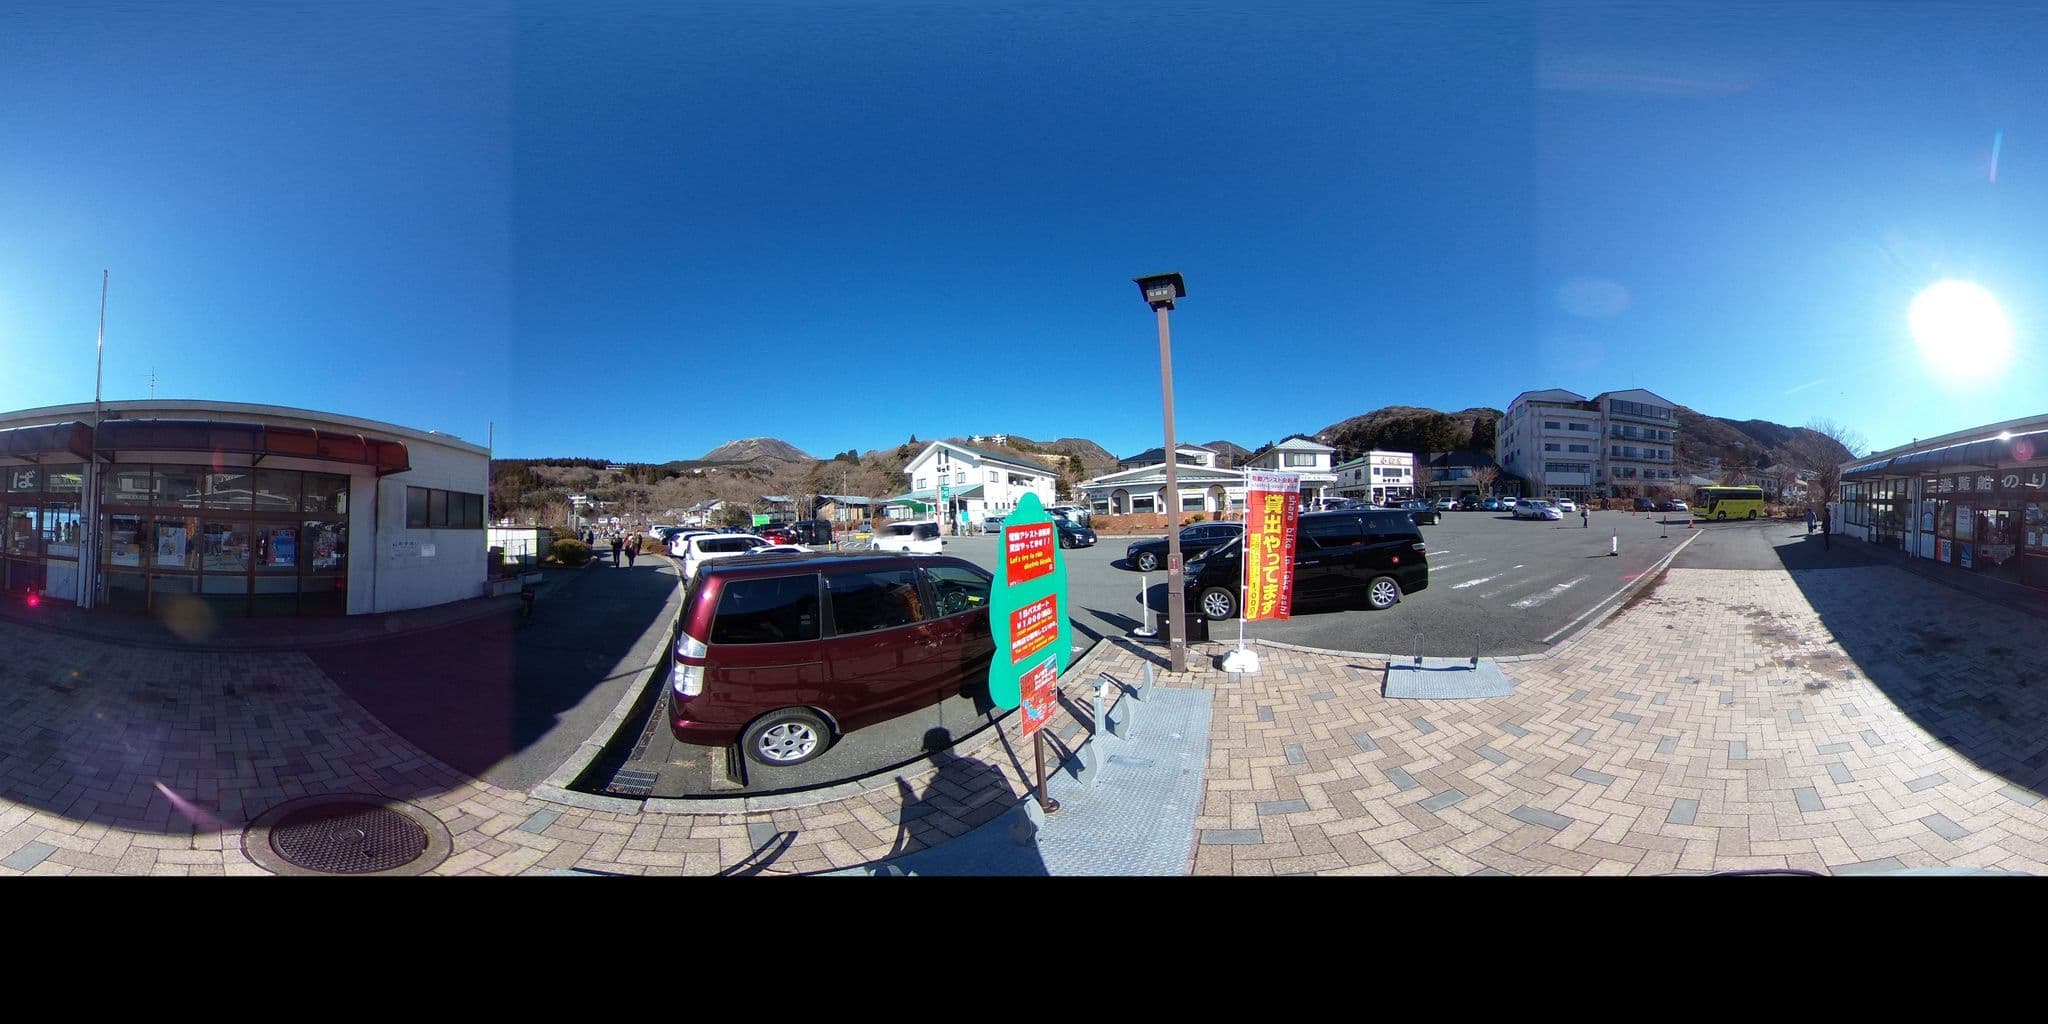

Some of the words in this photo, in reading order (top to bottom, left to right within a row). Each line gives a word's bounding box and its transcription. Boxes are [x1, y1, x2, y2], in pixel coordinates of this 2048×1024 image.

[1287, 495, 1296, 521] share
[1285, 528, 1294, 549] bike
[1261, 494, 1284, 616] 貸出やってます
